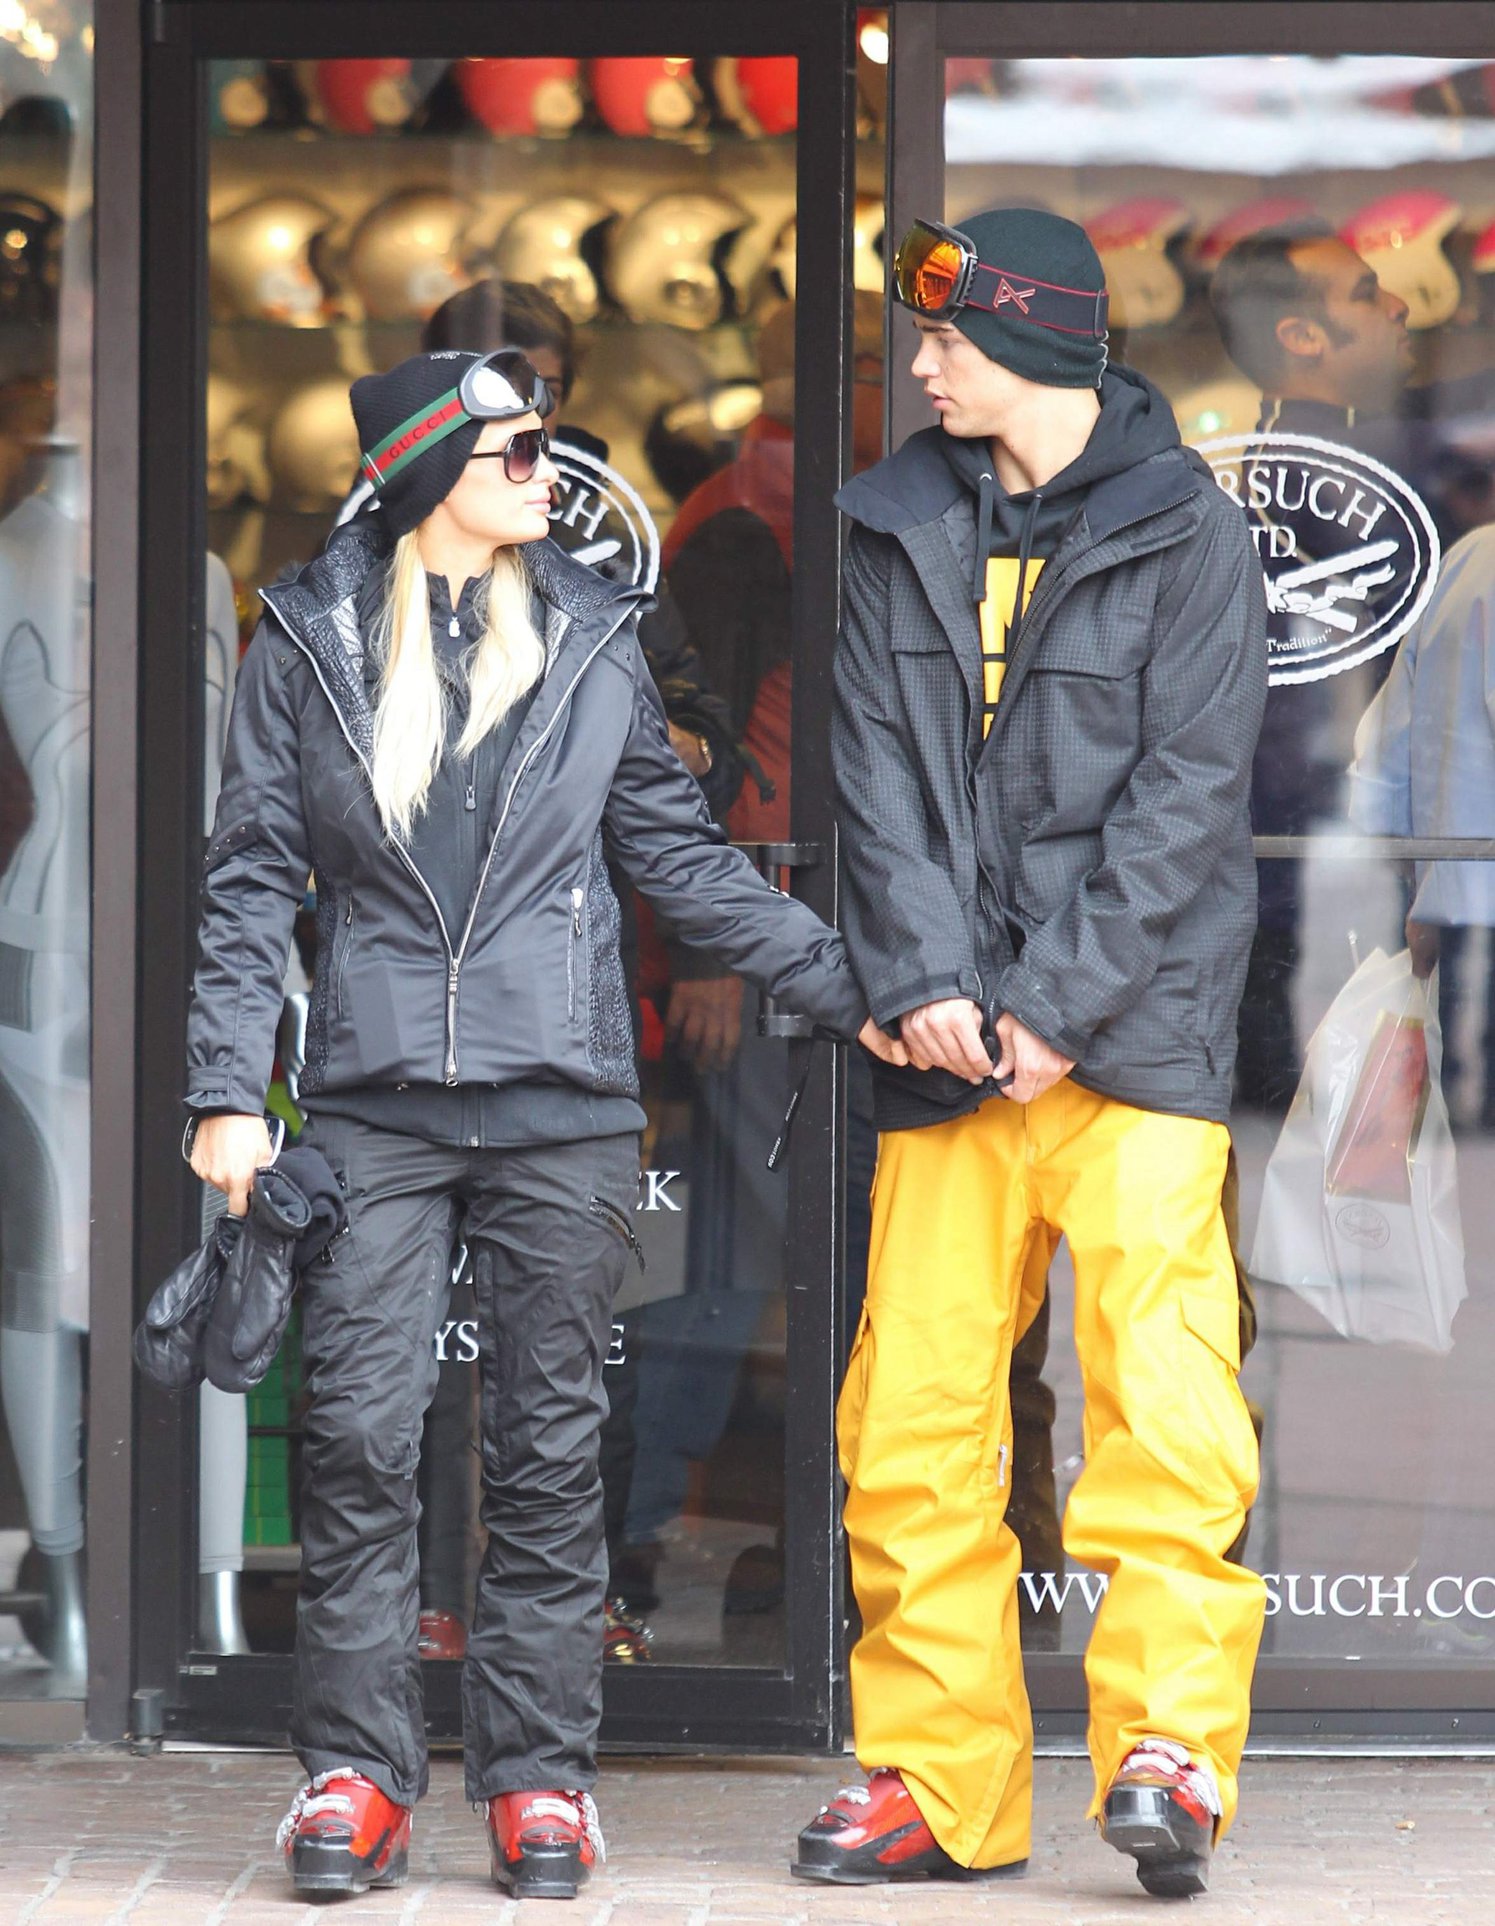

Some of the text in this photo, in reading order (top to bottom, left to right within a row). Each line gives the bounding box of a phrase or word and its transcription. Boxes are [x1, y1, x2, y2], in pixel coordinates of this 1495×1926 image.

[388, 409, 447, 459] GUCCI
[1215, 466, 1387, 541] RSUCH
[1248, 525, 1298, 558] TD.
[434, 1320, 480, 1362] YS
